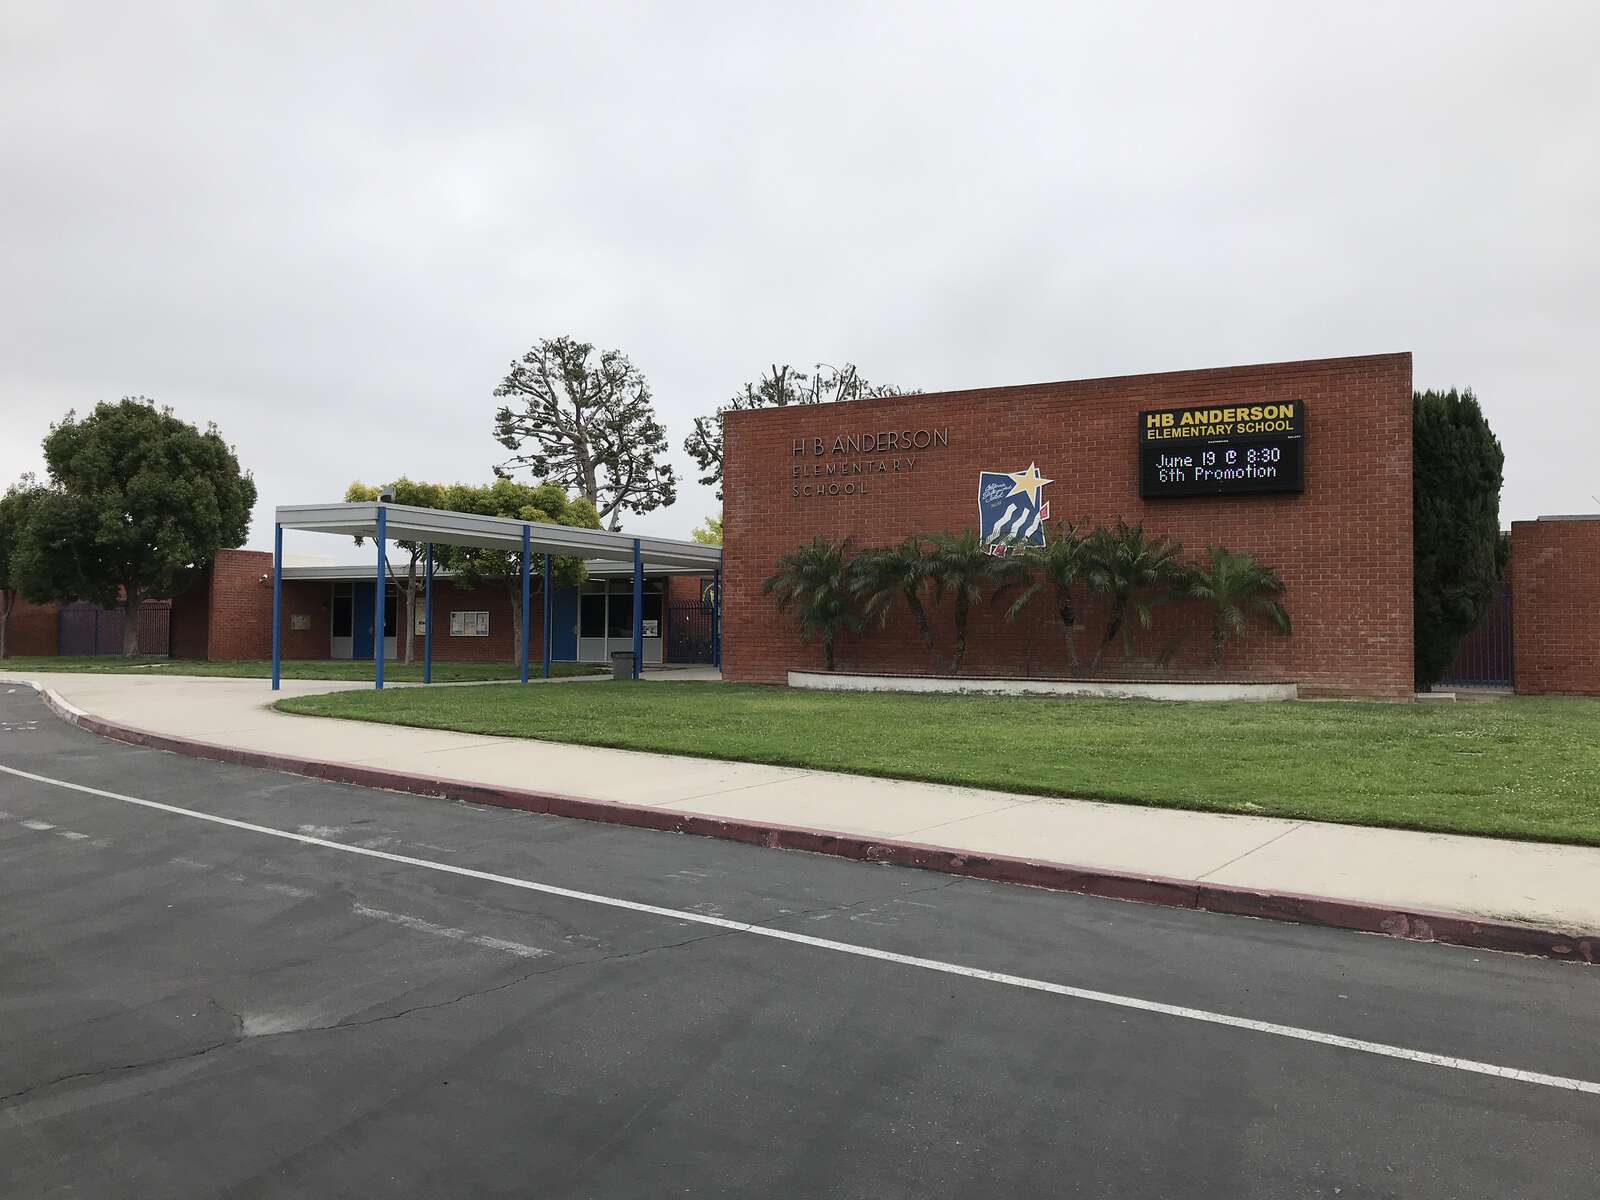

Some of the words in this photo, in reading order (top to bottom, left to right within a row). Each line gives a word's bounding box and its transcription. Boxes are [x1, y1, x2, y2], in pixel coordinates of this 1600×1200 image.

[1147, 413, 1175, 428] HB
[1180, 404, 1294, 426] ANDERSON
[1147, 424, 1233, 440] ELEMENTARY
[1237, 420, 1294, 433] SCHOOL
[792, 439, 805, 456] H
[813, 437, 824, 456] B
[832, 428, 949, 454] ANDERSON
[792, 458, 915, 477] ELEMENTARY
[1156, 454, 1193, 468] June
[1202, 451, 1216, 466] 19
[1247, 447, 1281, 463] 8:30
[1159, 467, 1185, 483] 6th
[1195, 464, 1277, 481] Promotion
[792, 482, 867, 497] SCHOOL
